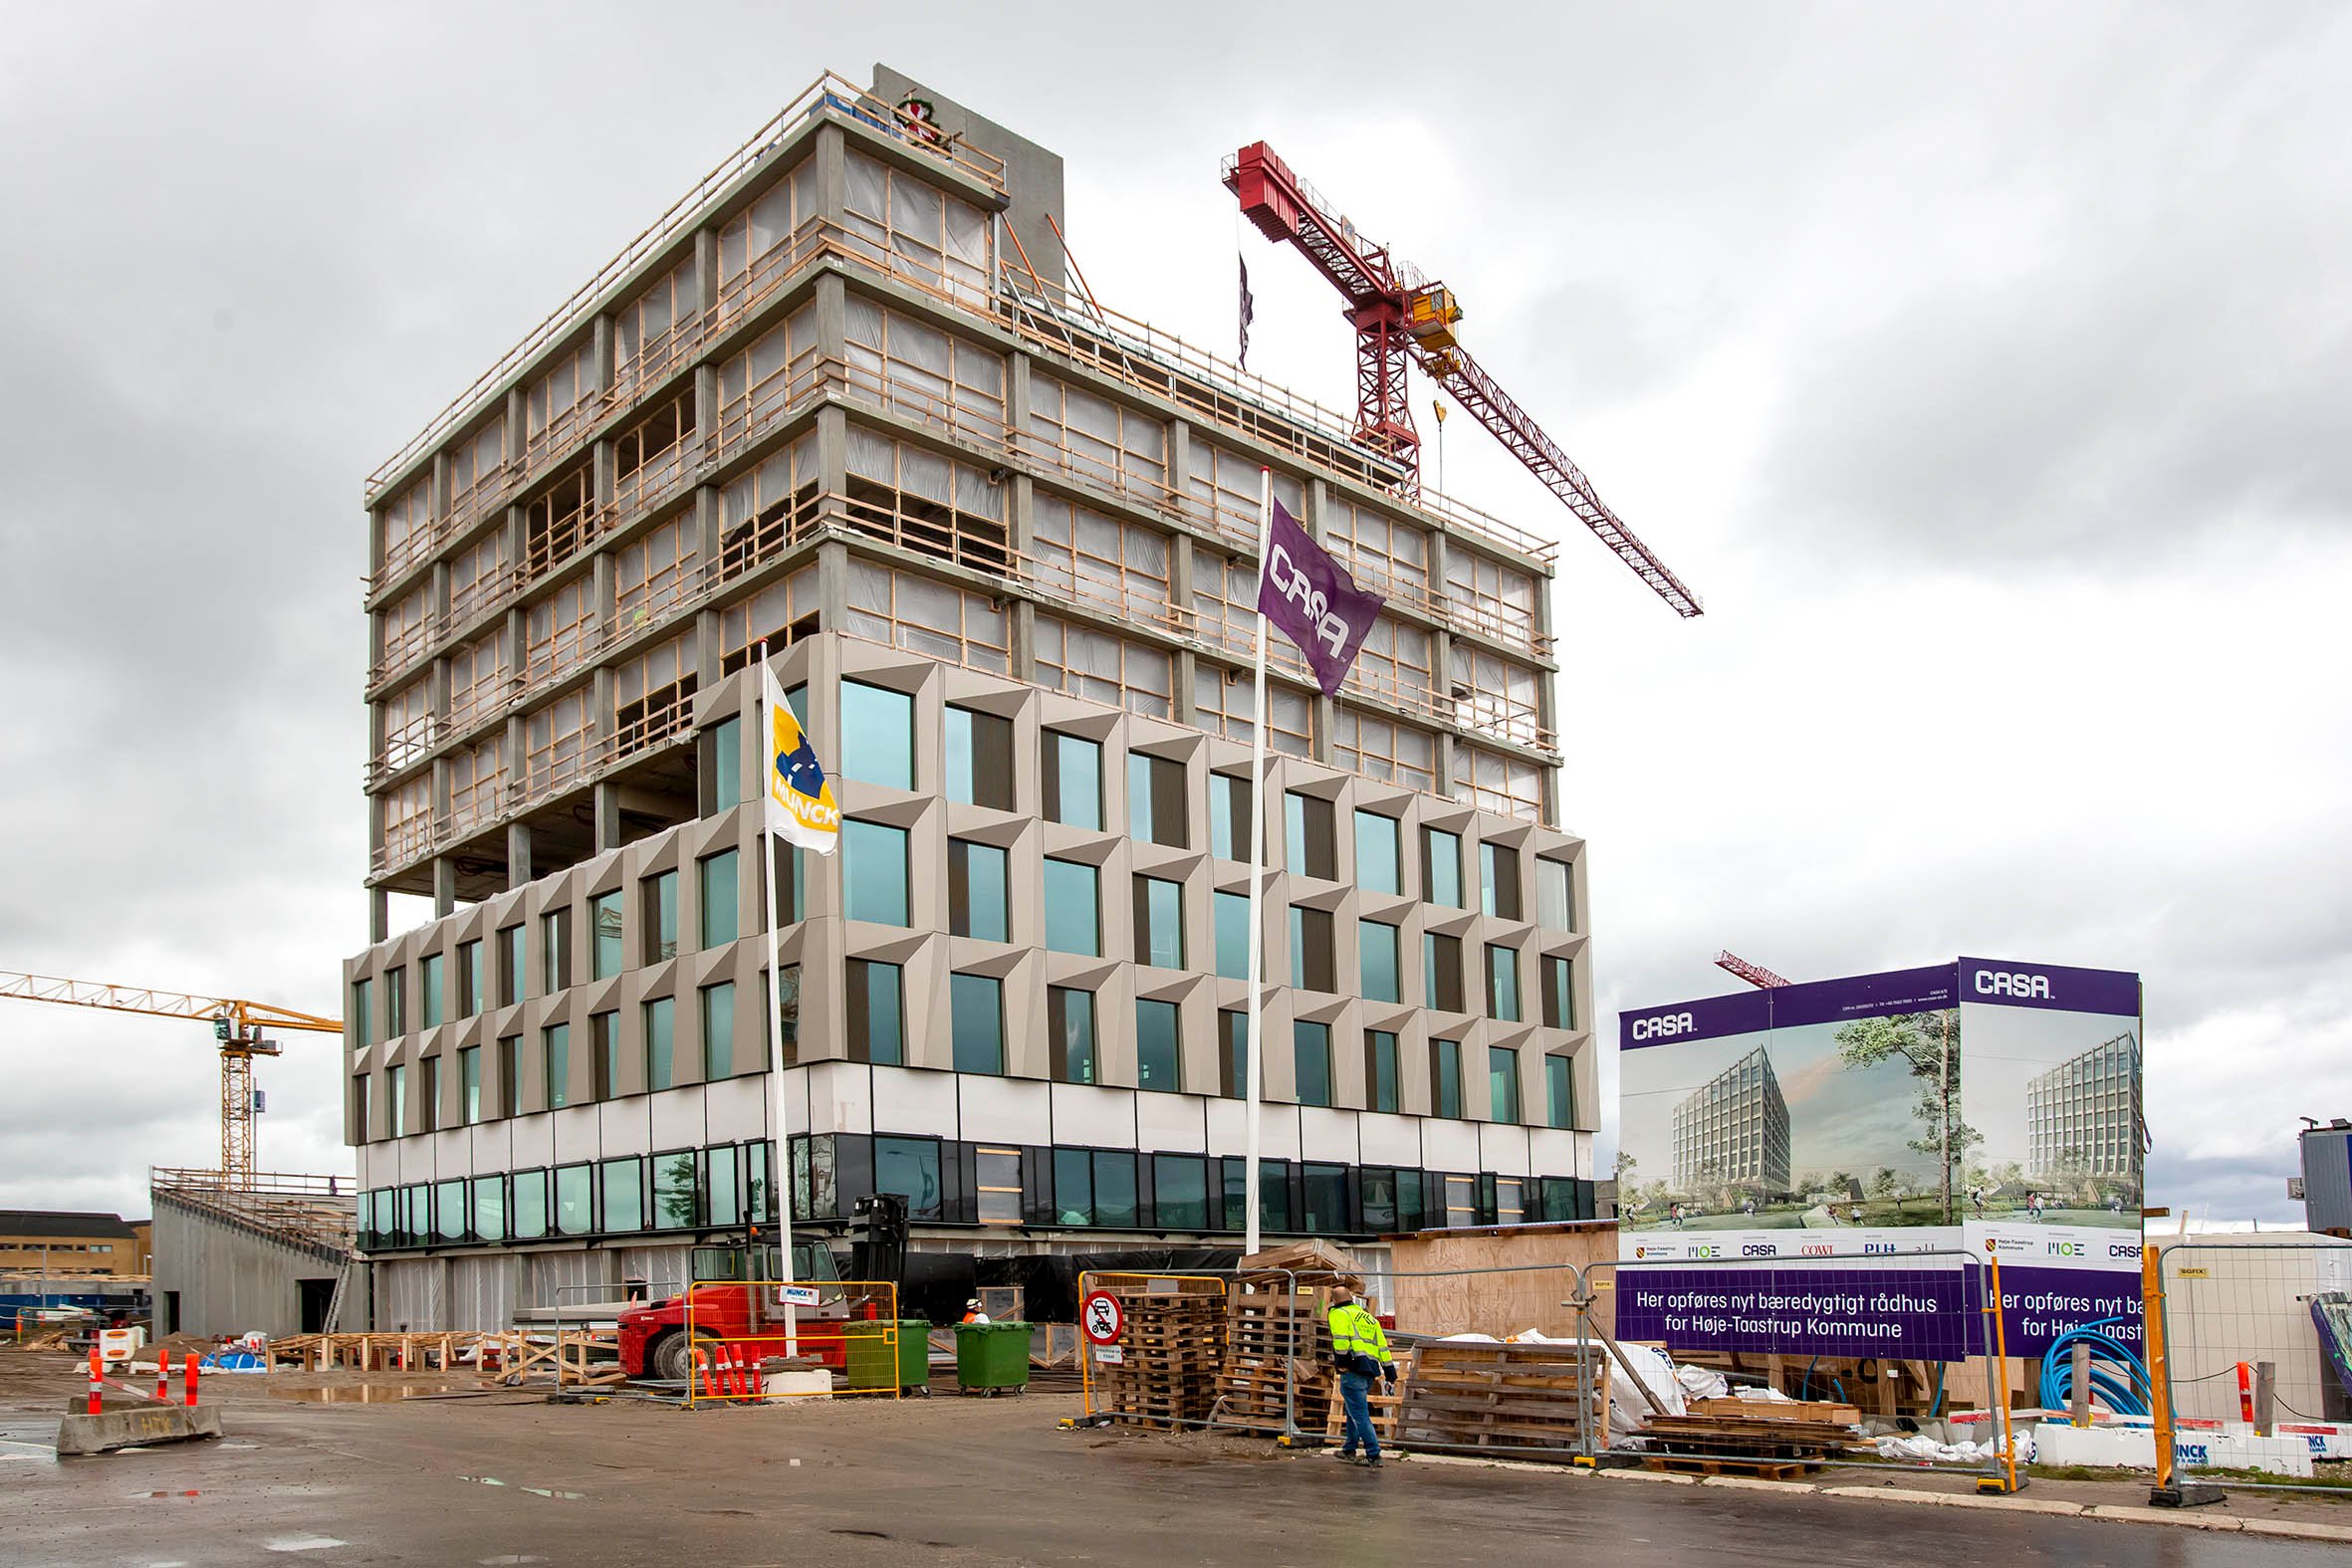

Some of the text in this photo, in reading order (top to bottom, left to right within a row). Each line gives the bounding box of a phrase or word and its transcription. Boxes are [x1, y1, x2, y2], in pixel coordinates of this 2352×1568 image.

[1270, 544, 1349, 658] CASA
[775, 776, 839, 825] MUNCK
[1975, 970, 2049, 999] CASA
[1633, 1012, 1693, 1040] CASA
[1743, 1244, 1776, 1256] CASA
[1800, 1244, 1833, 1256] COWI
[1637, 1291, 1937, 1315] Her opføres nyt bæredygtigt rådhus
[2024, 1292, 2090, 1314] opføres
[2095, 1296, 2122, 1317] nyt
[1665, 1314, 1902, 1338] for Høje-Taastrup Kommune
[2021, 1317, 2047, 1335] for
[2176, 1445, 2207, 1457] NCK
